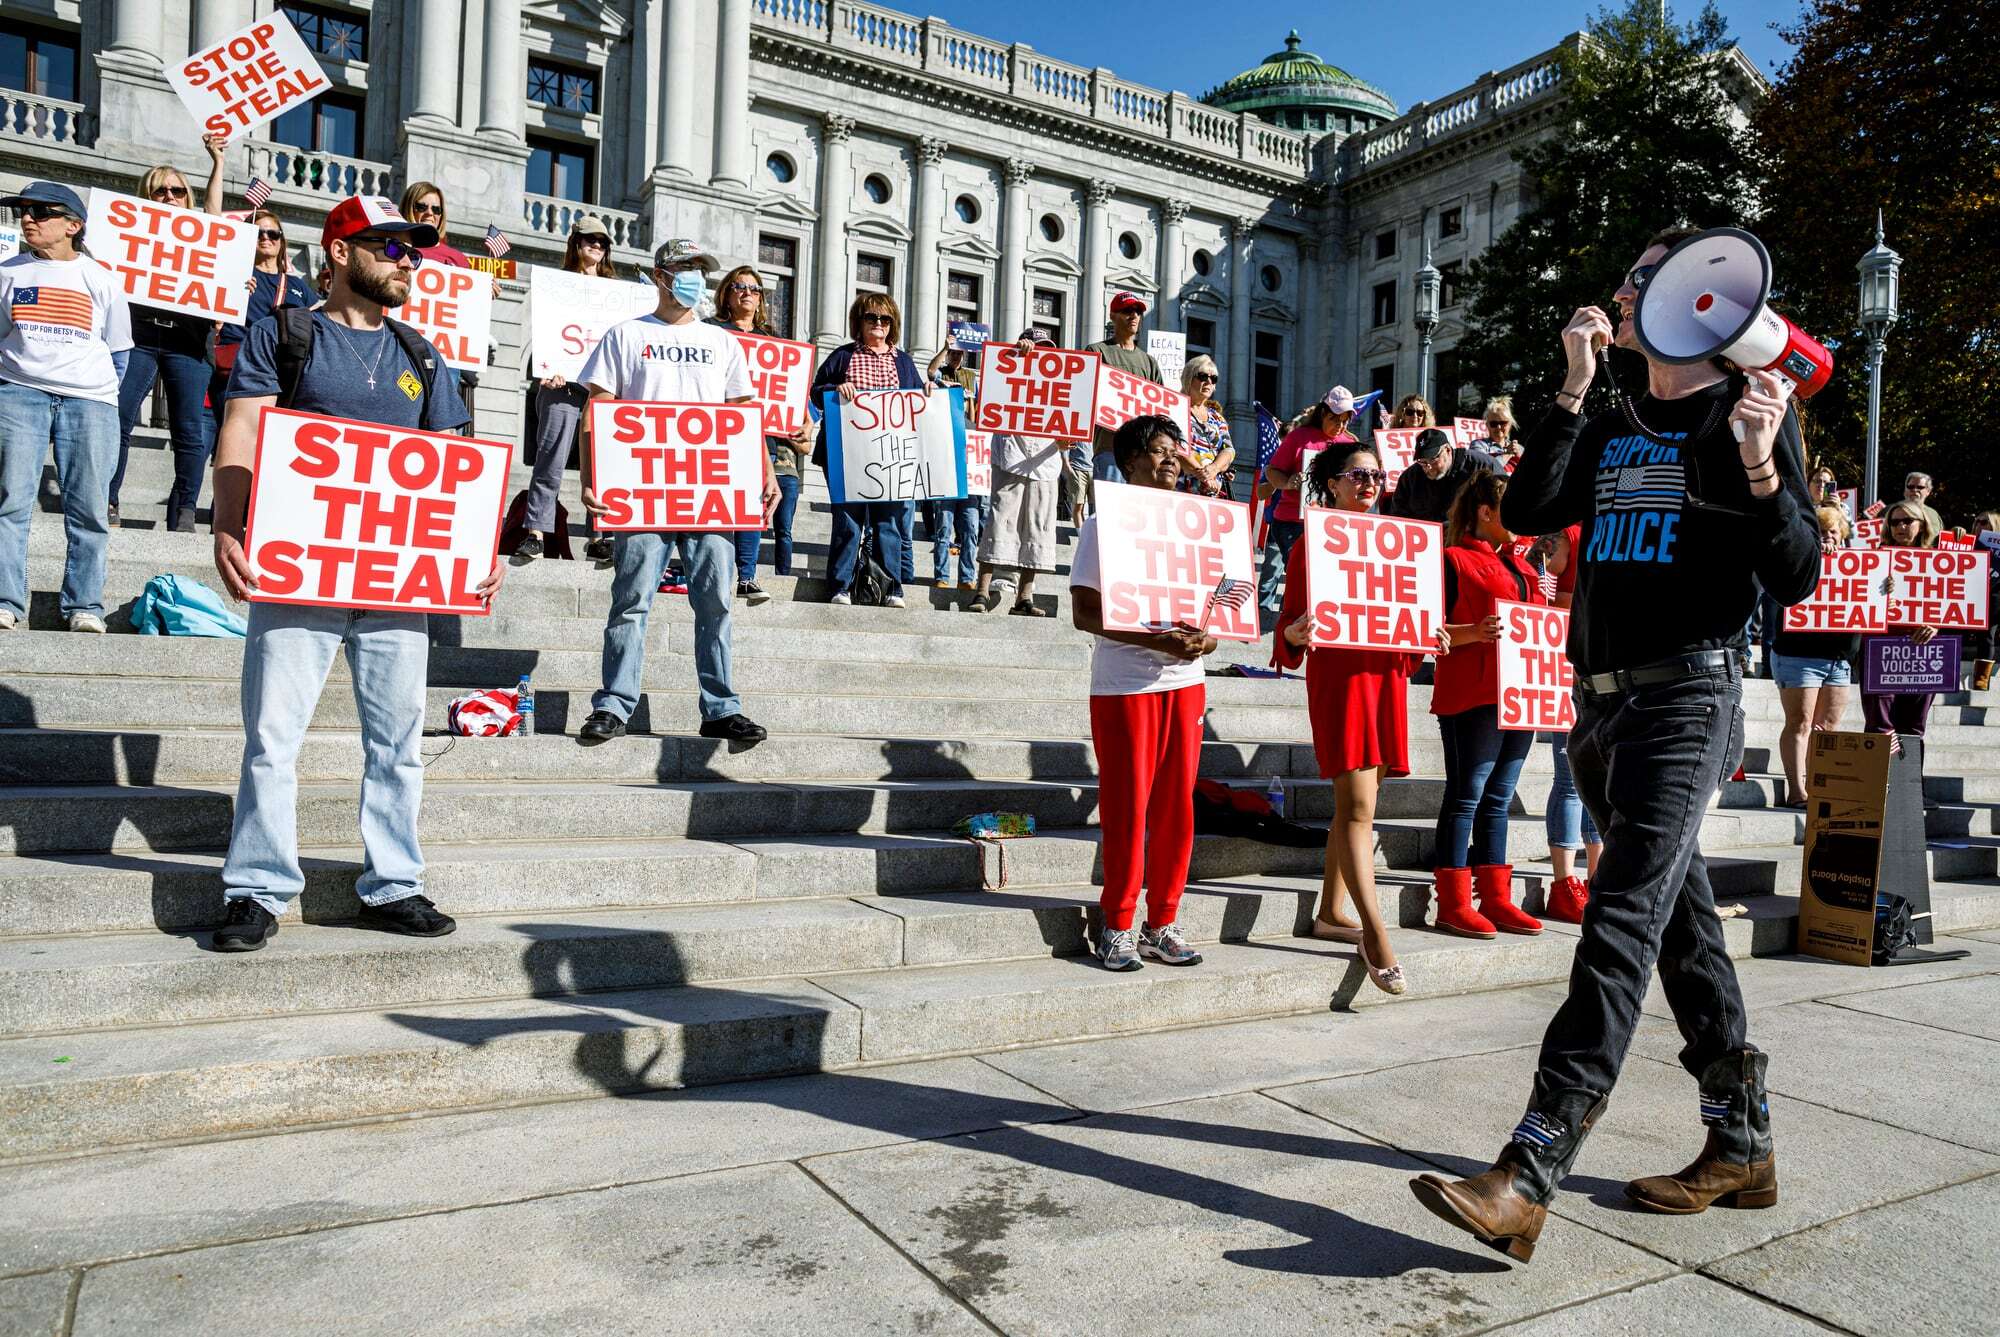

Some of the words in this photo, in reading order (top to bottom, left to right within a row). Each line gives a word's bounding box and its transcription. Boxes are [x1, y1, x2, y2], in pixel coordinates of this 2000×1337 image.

[183, 24, 275, 86] STOP
[206, 51, 288, 103] THE
[205, 69, 324, 138] STEAL
[107, 200, 236, 248] STOP
[119, 233, 217, 279] THE
[478, 257, 510, 278] HOPE
[96, 259, 239, 316] TEAL
[416, 268, 473, 299] OP
[29, 324, 39, 333] UP
[40, 326, 53, 335] FOR
[53, 327, 74, 336] BETSY
[383, 297, 458, 329] HE
[952, 328, 989, 337] TRUMP
[737, 337, 801, 372] TOP
[995, 349, 1085, 379] STOP
[749, 370, 788, 402] HE
[1006, 377, 1071, 407] THE
[1108, 371, 1179, 408] STOP
[613, 406, 745, 445] STOP
[850, 391, 926, 432] STOP
[982, 403, 1088, 437] STEAL
[1461, 420, 1488, 431] STO
[289, 423, 484, 494] STOP
[872, 433, 918, 461] THE
[1386, 433, 1418, 449] ST
[631, 448, 730, 485] THE
[858, 461, 945, 501] STEAL
[314, 485, 456, 550] THE
[601, 488, 761, 525] STEAL
[1120, 495, 1235, 543] STOP
[1324, 515, 1428, 562] STOP
[1586, 511, 1681, 563] POLICE
[1857, 520, 1884, 538] ST
[1941, 541, 1973, 551] TRUMP
[257, 540, 482, 608] STEAL
[1136, 539, 1224, 587] THE
[1822, 552, 1879, 576] TOP
[1894, 551, 1976, 575] STOP
[1339, 560, 1418, 605] THE
[1815, 578, 1868, 602] THE
[1904, 576, 1965, 600] THE
[1110, 581, 1255, 635] STEAL
[1315, 601, 1441, 647] STEAL
[1789, 604, 1884, 629] STEAL
[1510, 607, 1570, 648] STO
[1520, 648, 1573, 687] THE
[1881, 660, 1927, 673] VOICES
[1882, 645, 1944, 660] PRO-LIFE
[1882, 675, 1904, 683] FOR
[1906, 675, 1942, 684] TRUMP
[1503, 687, 1575, 726] STEA
[1811, 869, 1838, 882] Board
[1838, 871, 1872, 887] Display
